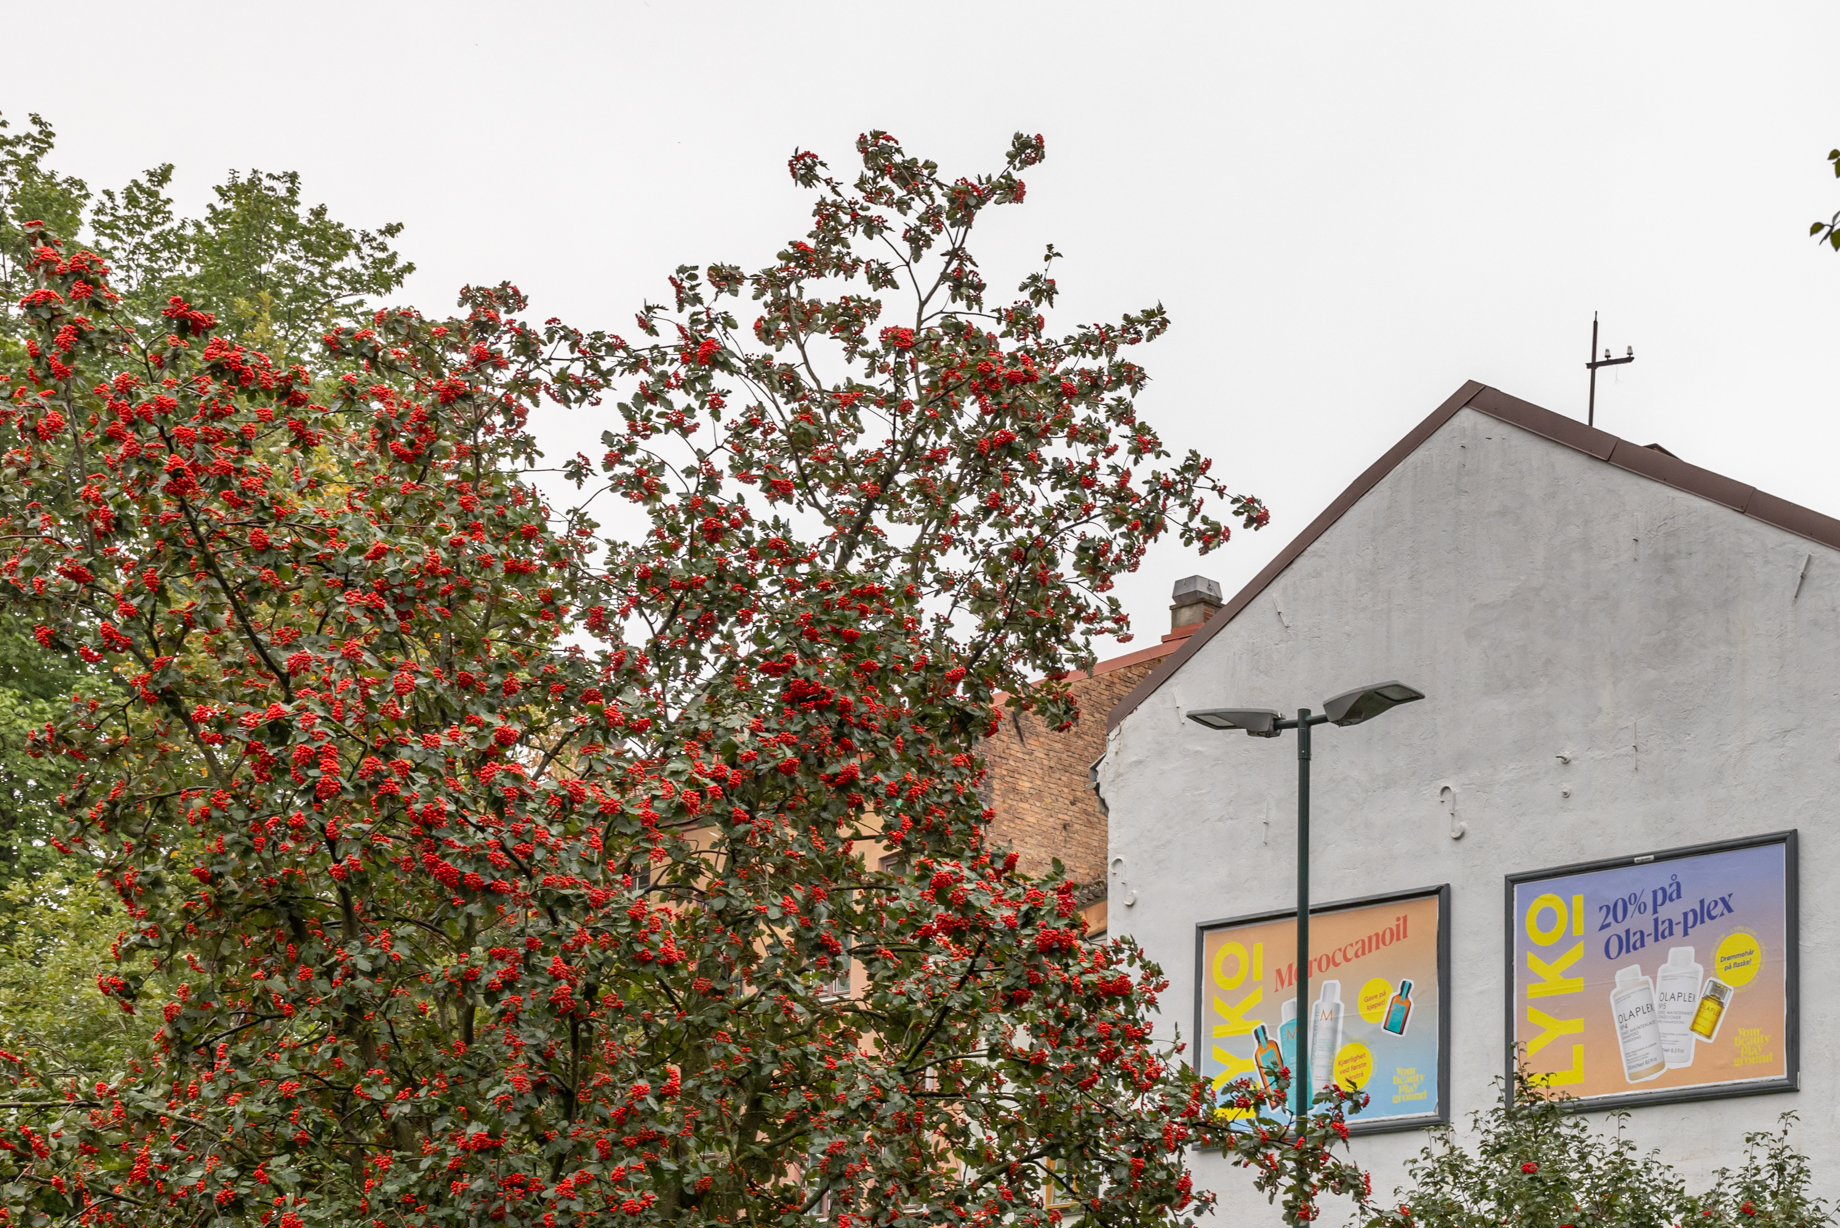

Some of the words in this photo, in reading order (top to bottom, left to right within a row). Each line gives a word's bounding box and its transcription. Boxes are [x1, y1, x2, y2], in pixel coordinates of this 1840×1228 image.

[1598, 888, 1647, 932] 20%
[1651, 873, 1682, 916] på
[1604, 892, 1735, 960] Ola-la-plex
[1526, 893, 1584, 1088] LYKO
